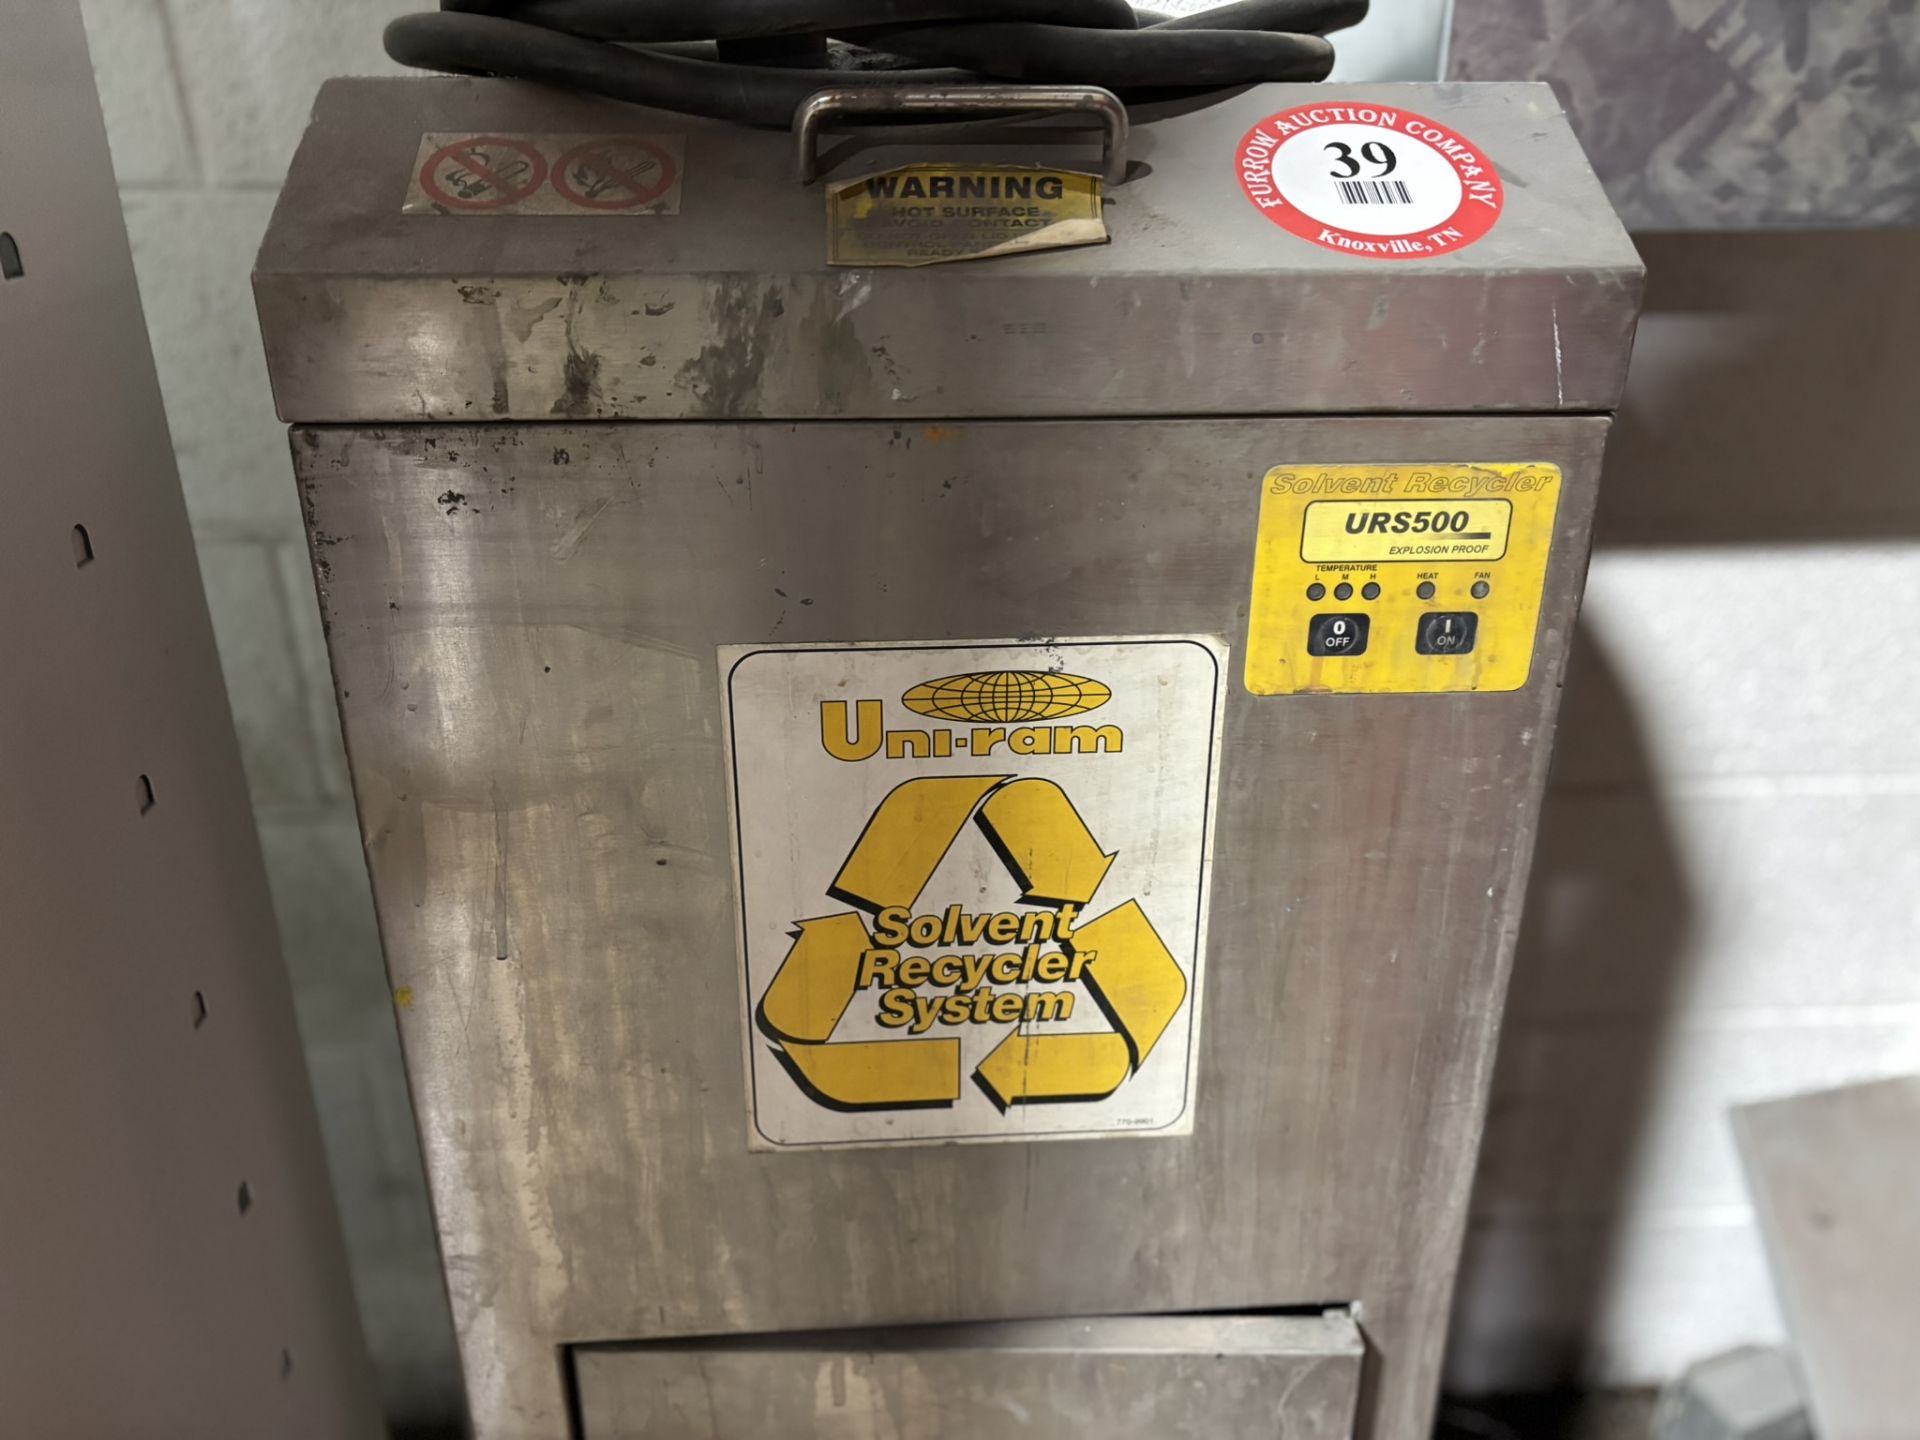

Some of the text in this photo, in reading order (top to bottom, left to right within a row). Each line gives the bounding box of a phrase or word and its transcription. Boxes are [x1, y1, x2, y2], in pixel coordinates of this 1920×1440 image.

[1242, 108, 1497, 209] FURROW AUCTION COMPANY
[1323, 141, 1397, 178] 39
[865, 176, 1064, 200] WARNING
[892, 206, 1040, 218] HOT SURFACE
[955, 219, 1052, 228] ONTACT
[1317, 226, 1464, 253] Knoxville, TN
[1270, 472, 1555, 497] Solvent Recycler
[1345, 510, 1470, 534] URS500
[1389, 544, 1489, 555] EXPLOSION PROOF
[1316, 564, 1378, 573] TEMPERATURE
[1417, 572, 1439, 580] HEAT
[1474, 572, 1491, 580] FAN
[1325, 637, 1351, 647] OFF
[1437, 636, 1456, 646] ON
[871, 903, 1080, 950] Solvent
[855, 943, 1098, 994] Recycler
[875, 986, 1075, 1035] System
